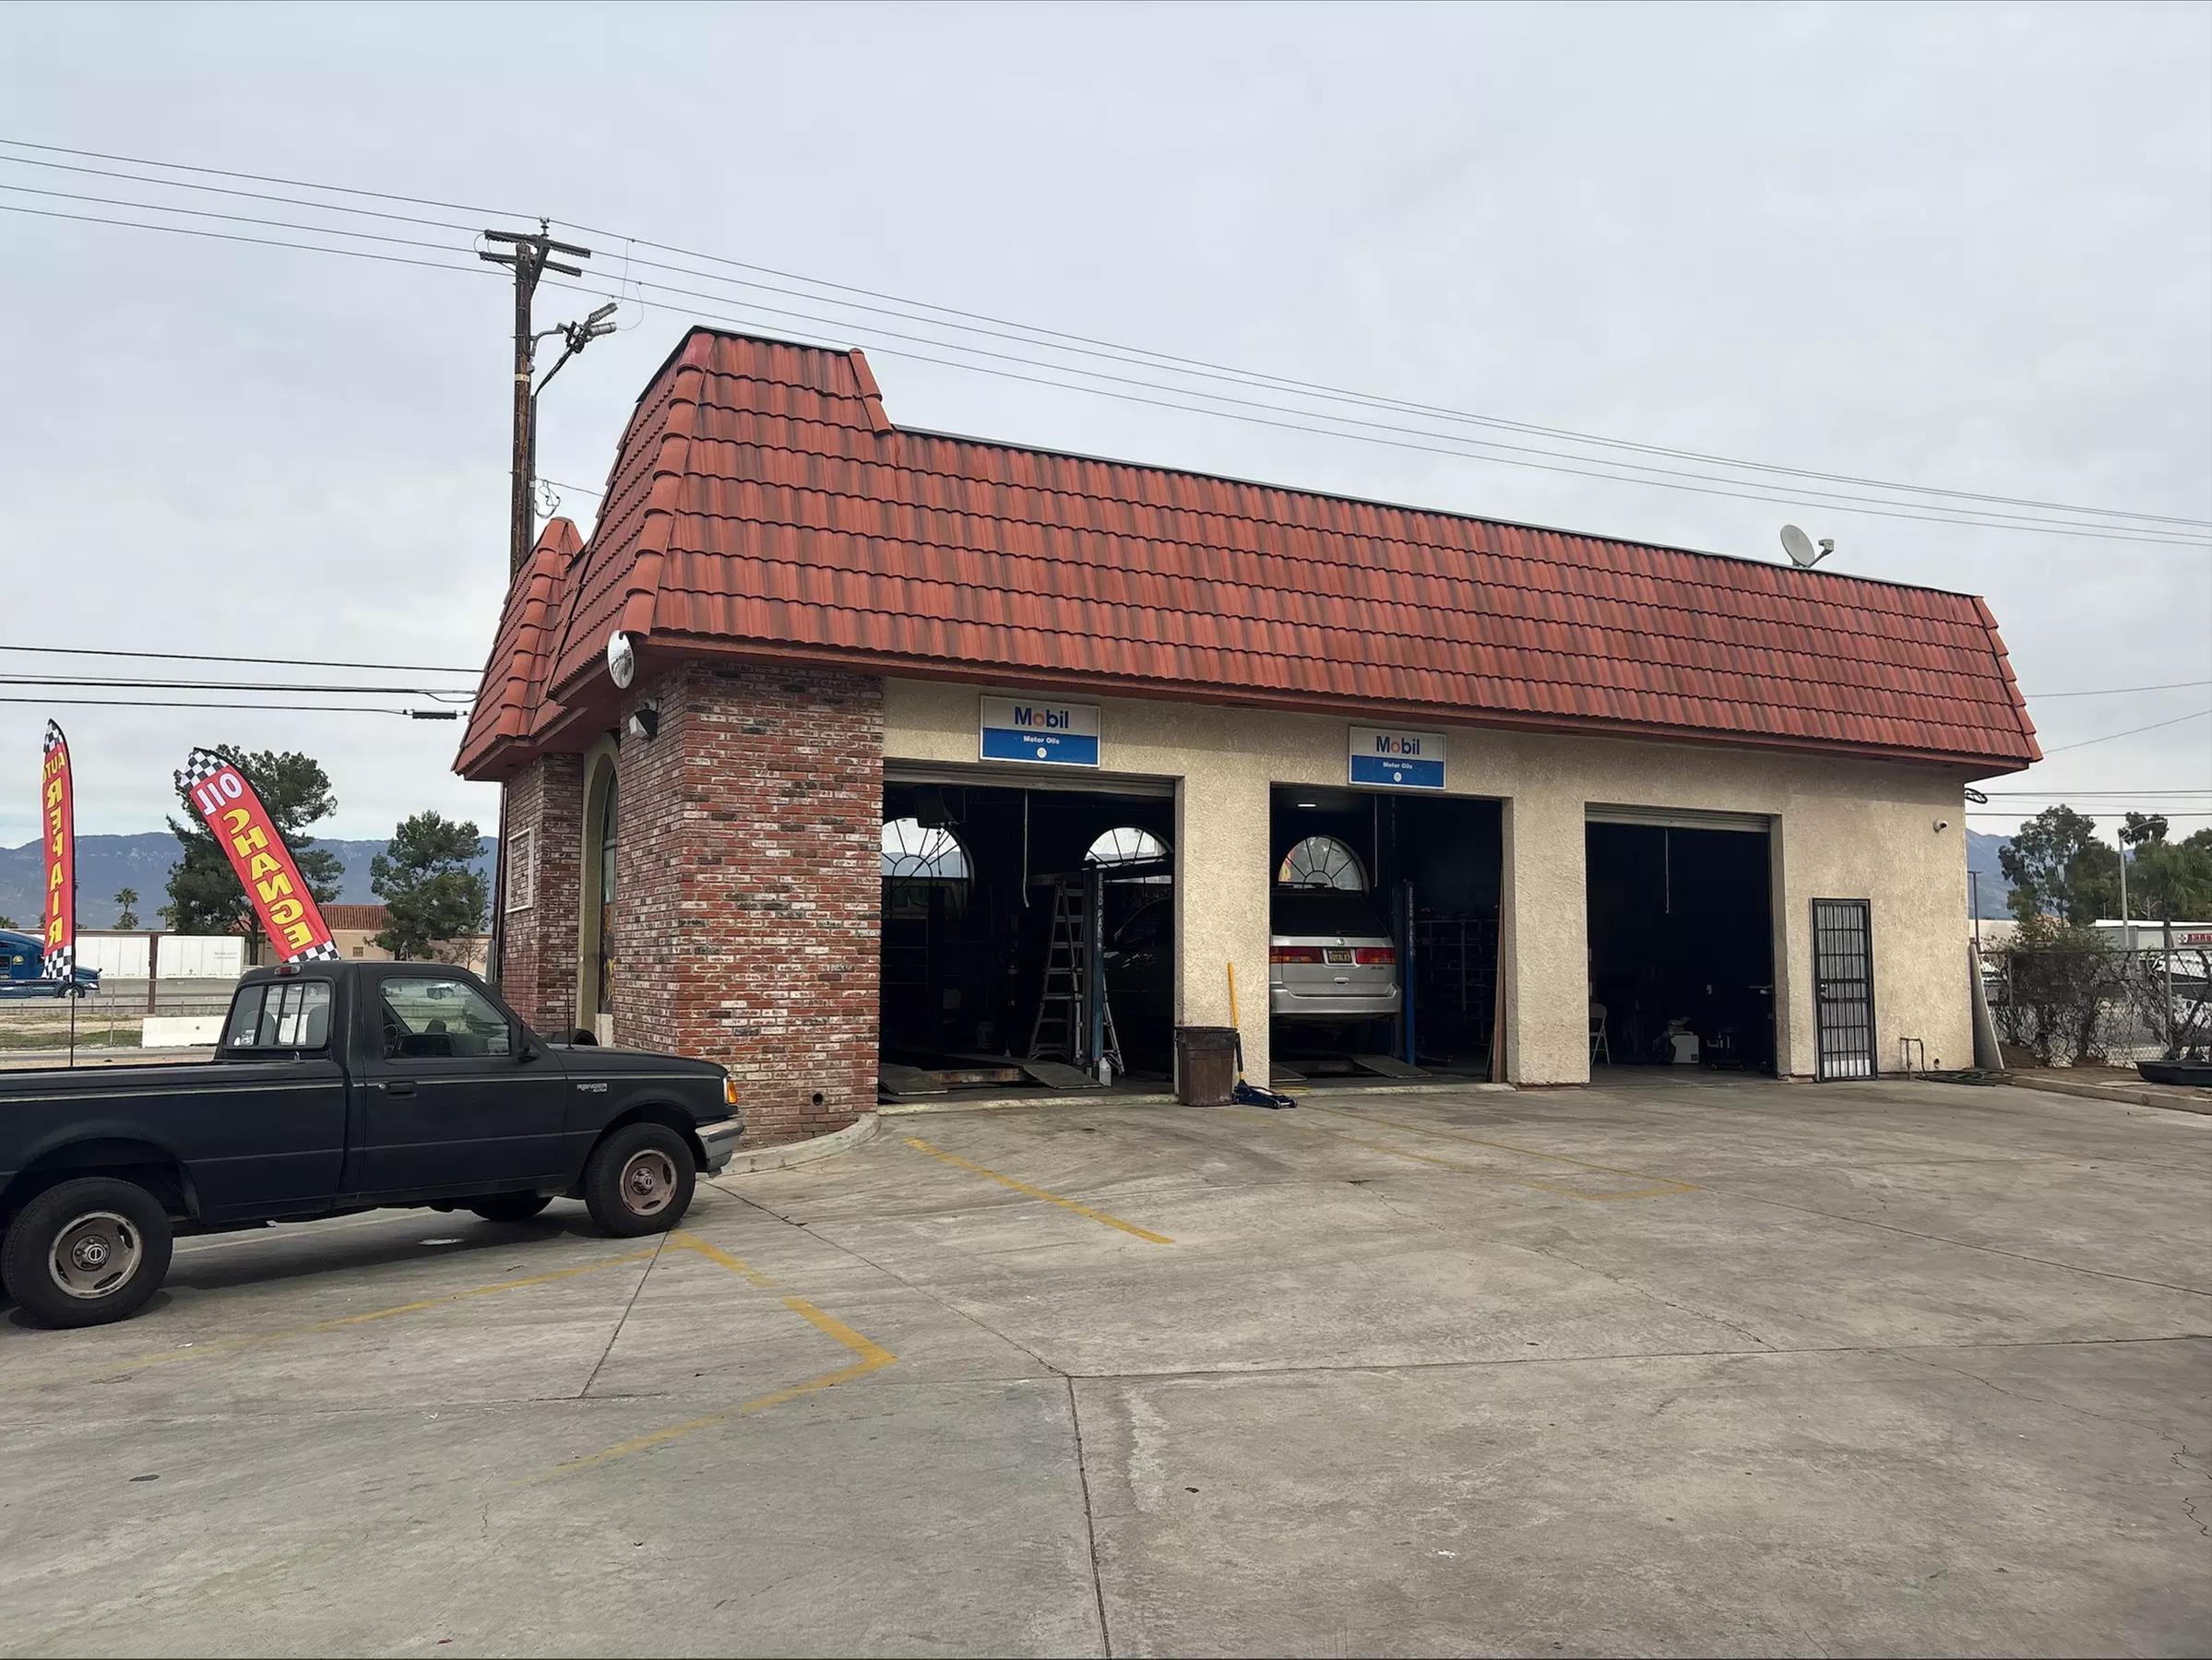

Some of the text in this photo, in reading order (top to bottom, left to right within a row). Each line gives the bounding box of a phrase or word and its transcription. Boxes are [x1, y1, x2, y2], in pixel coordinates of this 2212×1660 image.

[1015, 706, 1069, 729] Mobil
[1023, 735, 1045, 743] Motor
[1376, 736, 1421, 755] Mobil
